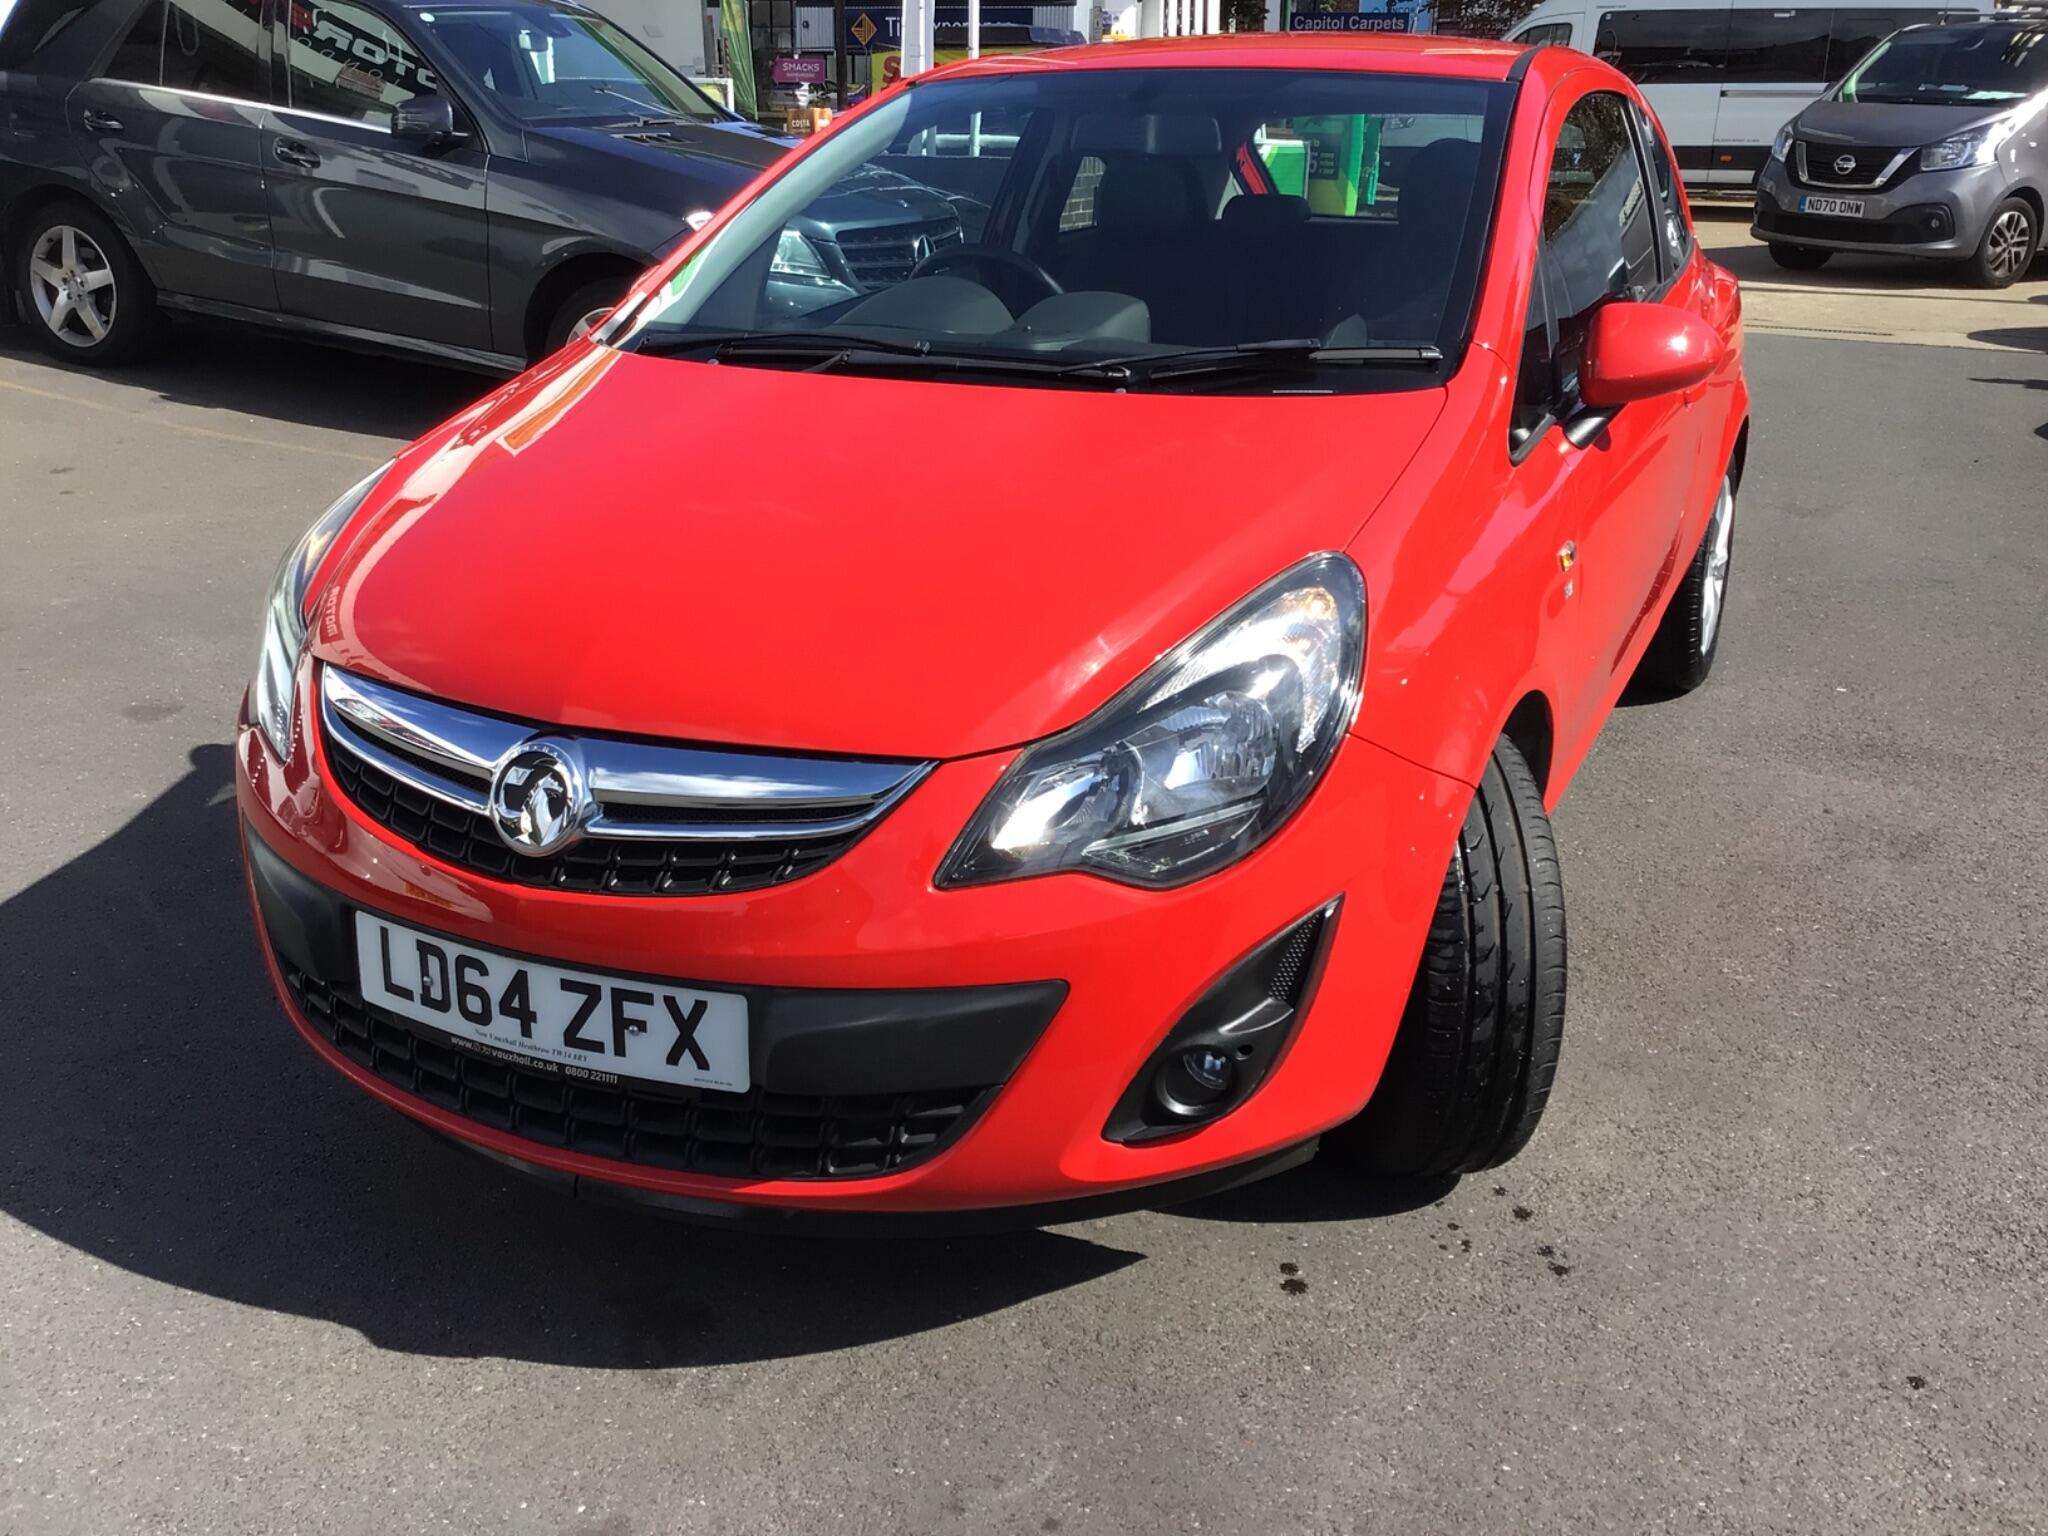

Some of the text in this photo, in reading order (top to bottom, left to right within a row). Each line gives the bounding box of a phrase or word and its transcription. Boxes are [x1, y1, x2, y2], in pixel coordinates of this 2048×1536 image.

[1294, 15, 1405, 32] Capitol Carpets
[791, 119, 811, 128] COSTA
[1807, 198, 1837, 213] ND70
[379, 925, 712, 1071] LD64 ZFX
[565, 1066, 589, 1078] 0800
